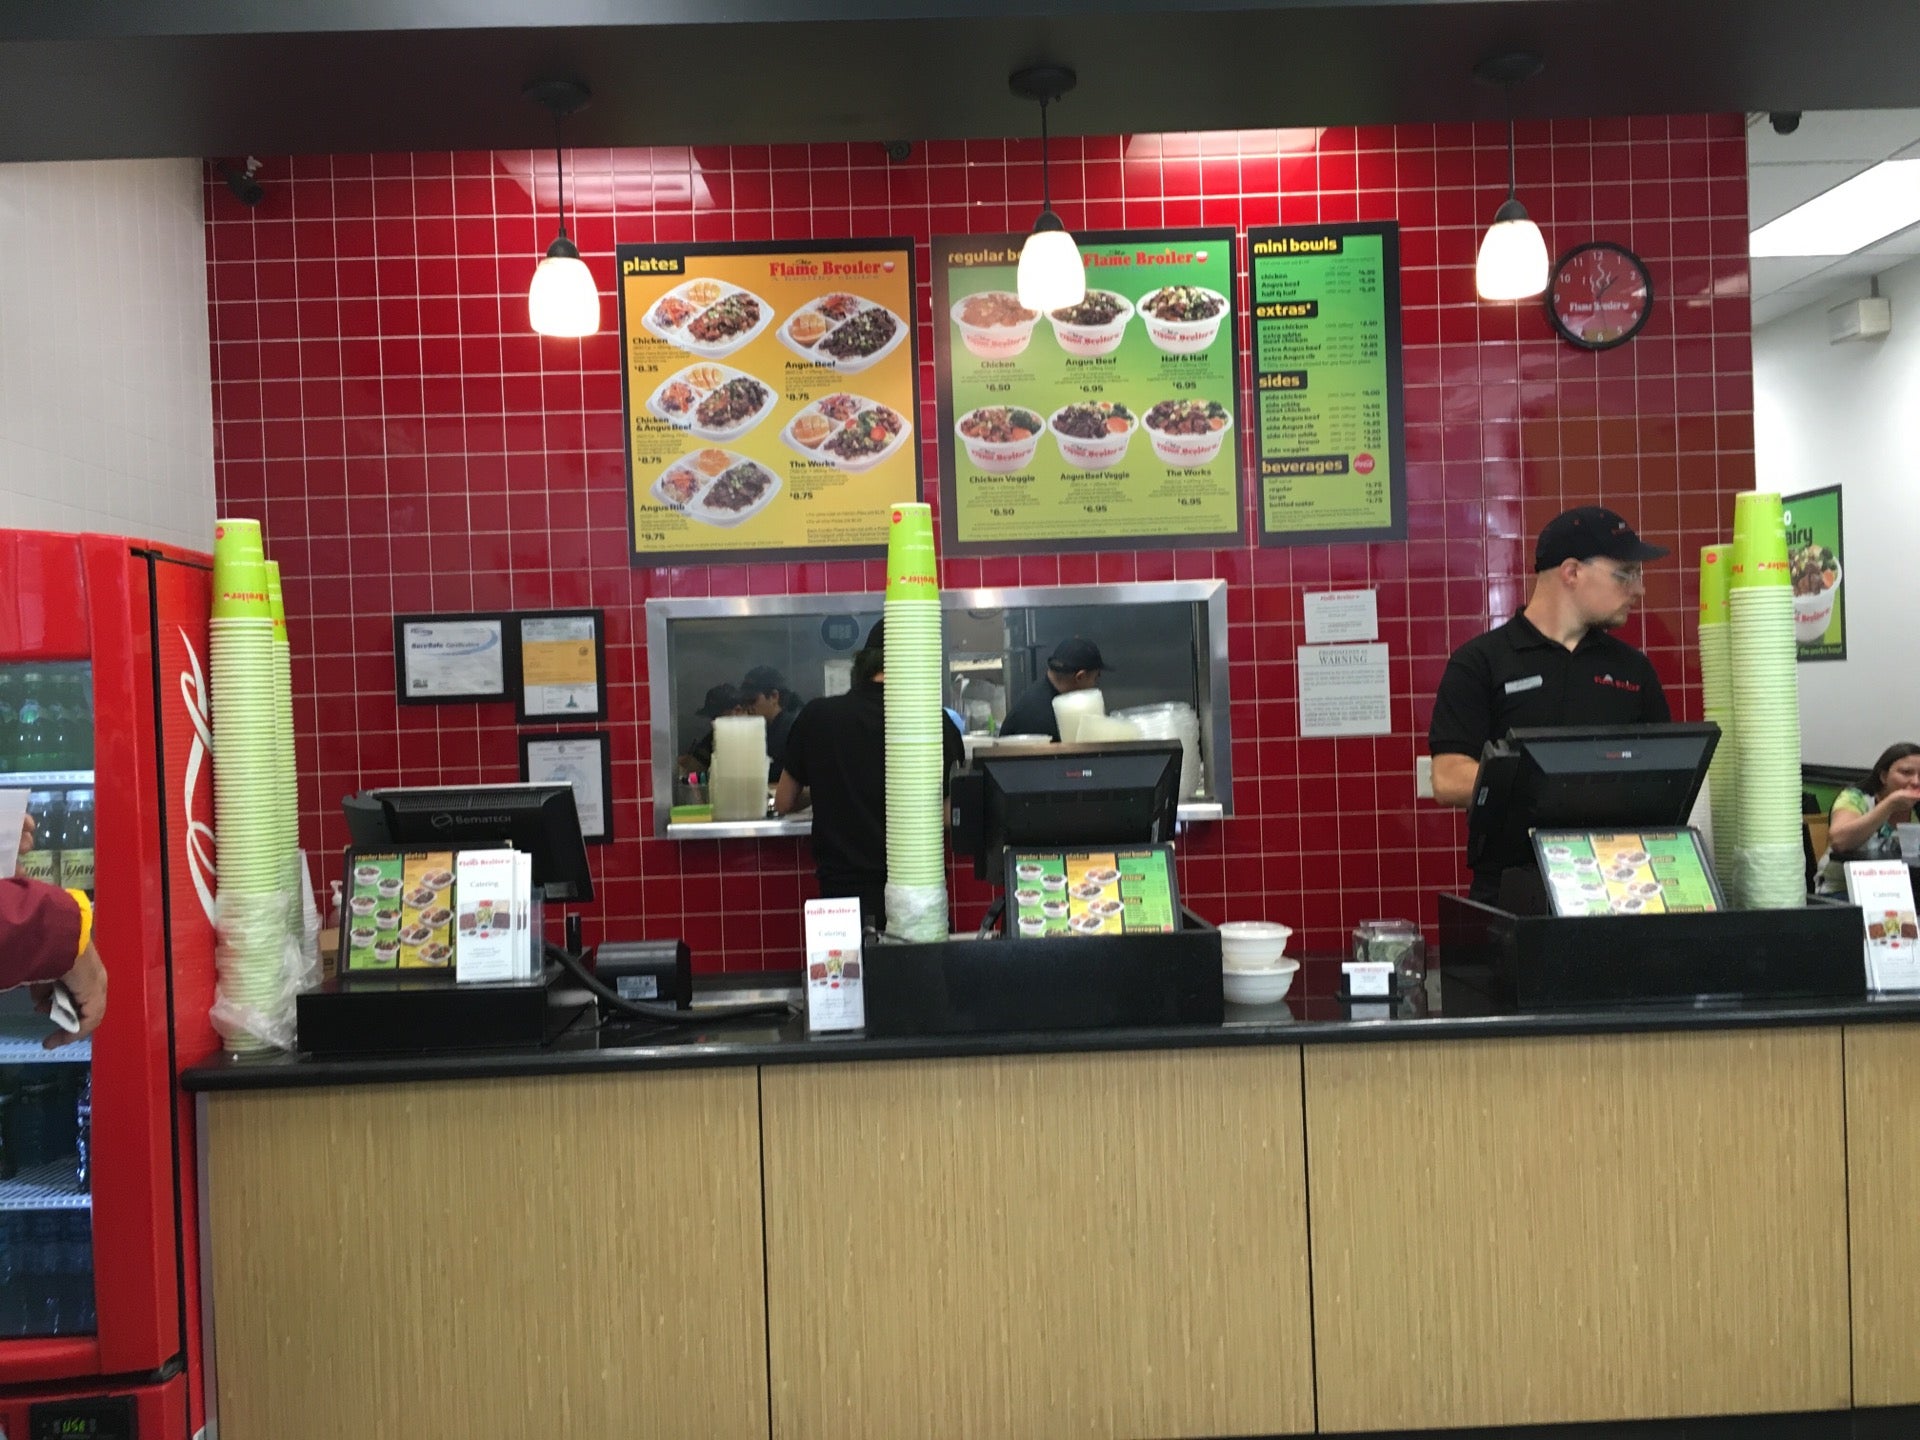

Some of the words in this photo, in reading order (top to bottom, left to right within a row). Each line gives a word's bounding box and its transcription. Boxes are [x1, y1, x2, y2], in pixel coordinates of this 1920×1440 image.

[1254, 239, 1287, 254] mini
[1290, 236, 1337, 252] bowls
[948, 249, 1004, 265] regular
[1083, 253, 1131, 268] Flame
[1136, 250, 1193, 265] Broiler
[624, 256, 678, 274] plates
[770, 261, 818, 276] Flame
[823, 260, 880, 275] Broiler
[1560, 274, 1571, 284] 10
[1630, 271, 1636, 281] 2
[1632, 310, 1637, 320] 4
[633, 337, 668, 345] Chicken
[1066, 358, 1093, 366] Angus
[1096, 356, 1116, 364] Beef
[1161, 354, 1179, 362] Half
[785, 361, 813, 369] Angus
[815, 360, 836, 368] Beef
[1259, 374, 1300, 388] sides
[636, 416, 669, 424] Chicken
[790, 460, 806, 468] The
[808, 460, 835, 468] Works
[1262, 459, 1343, 474] beverages
[1005, 474, 1035, 483] Veggie
[1061, 472, 1084, 481] Angus
[1104, 471, 1130, 480] Veggie
[1269, 485, 1292, 493] regular
[640, 504, 669, 512] Angus
[670, 503, 685, 511] Rib
[1269, 500, 1294, 508] bottled
[1787, 525, 1812, 547] airy
[230, 591, 265, 603] Broiler
[1319, 655, 1368, 665] WARNING
[470, 880, 498, 888] Catering
[1873, 891, 1900, 899] Catering
